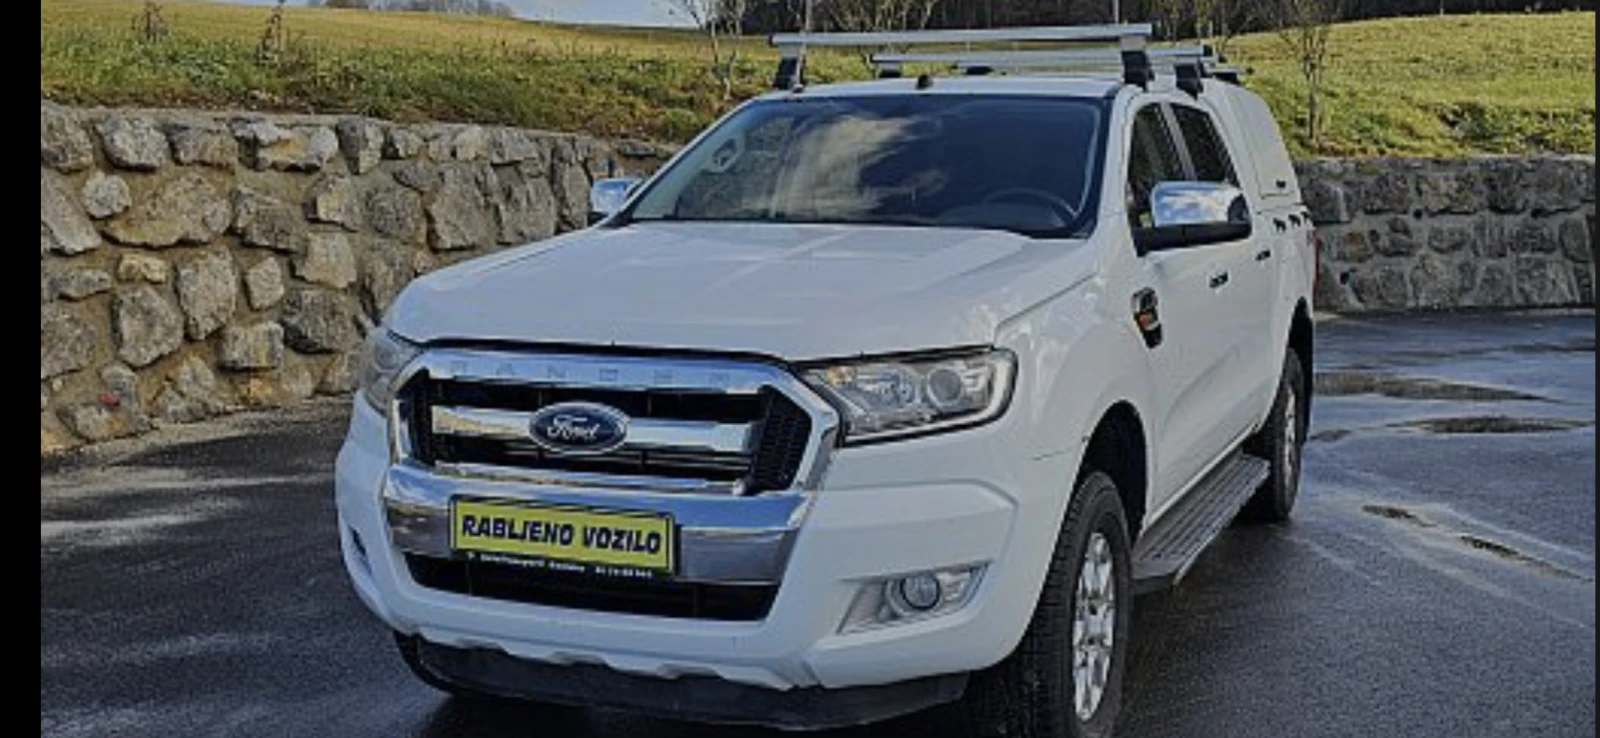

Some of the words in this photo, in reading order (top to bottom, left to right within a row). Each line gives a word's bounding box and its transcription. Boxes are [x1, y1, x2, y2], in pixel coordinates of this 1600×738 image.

[546, 414, 600, 440] Ford
[462, 515, 575, 546] RABLJENO
[582, 525, 662, 554] VOZILO
